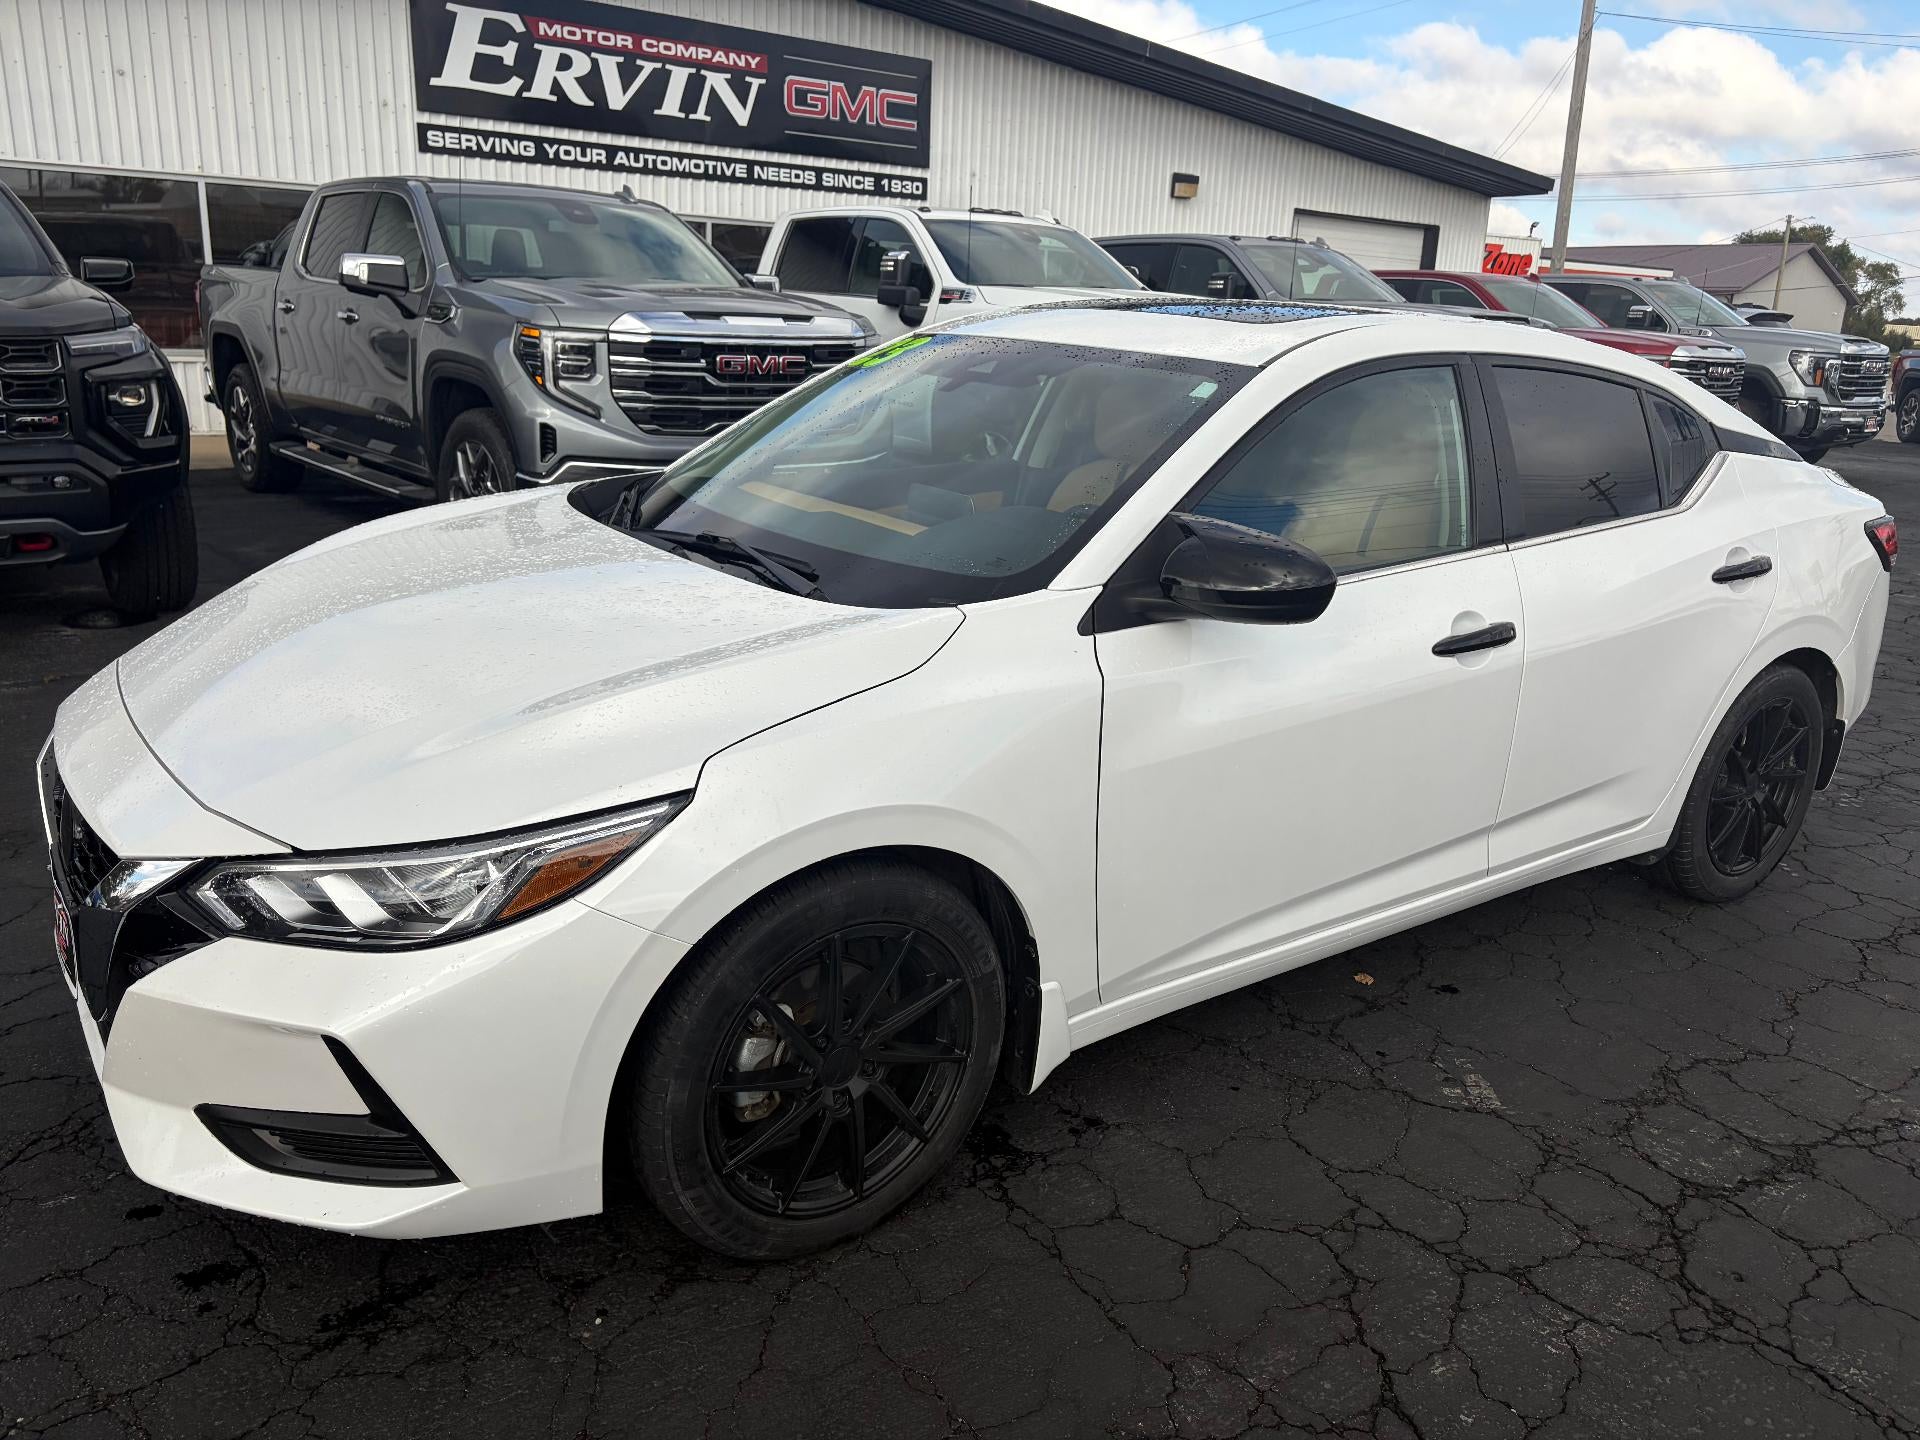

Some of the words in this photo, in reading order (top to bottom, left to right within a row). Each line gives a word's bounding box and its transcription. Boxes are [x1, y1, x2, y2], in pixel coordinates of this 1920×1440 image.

[429, 2, 767, 127] ERVIN
[538, 22, 633, 49] MOTOR
[642, 38, 761, 69] COMPANY
[784, 75, 918, 130] GMC
[426, 130, 535, 157] SERVING
[543, 143, 607, 164] YOUR
[613, 151, 747, 178] AUTOMOTIVE
[753, 165, 816, 185] NEEDS
[822, 173, 875, 190] SINCE
[881, 178, 922, 195] 1930
[1482, 243, 1532, 277] Zone
[716, 354, 806, 375] GMC
